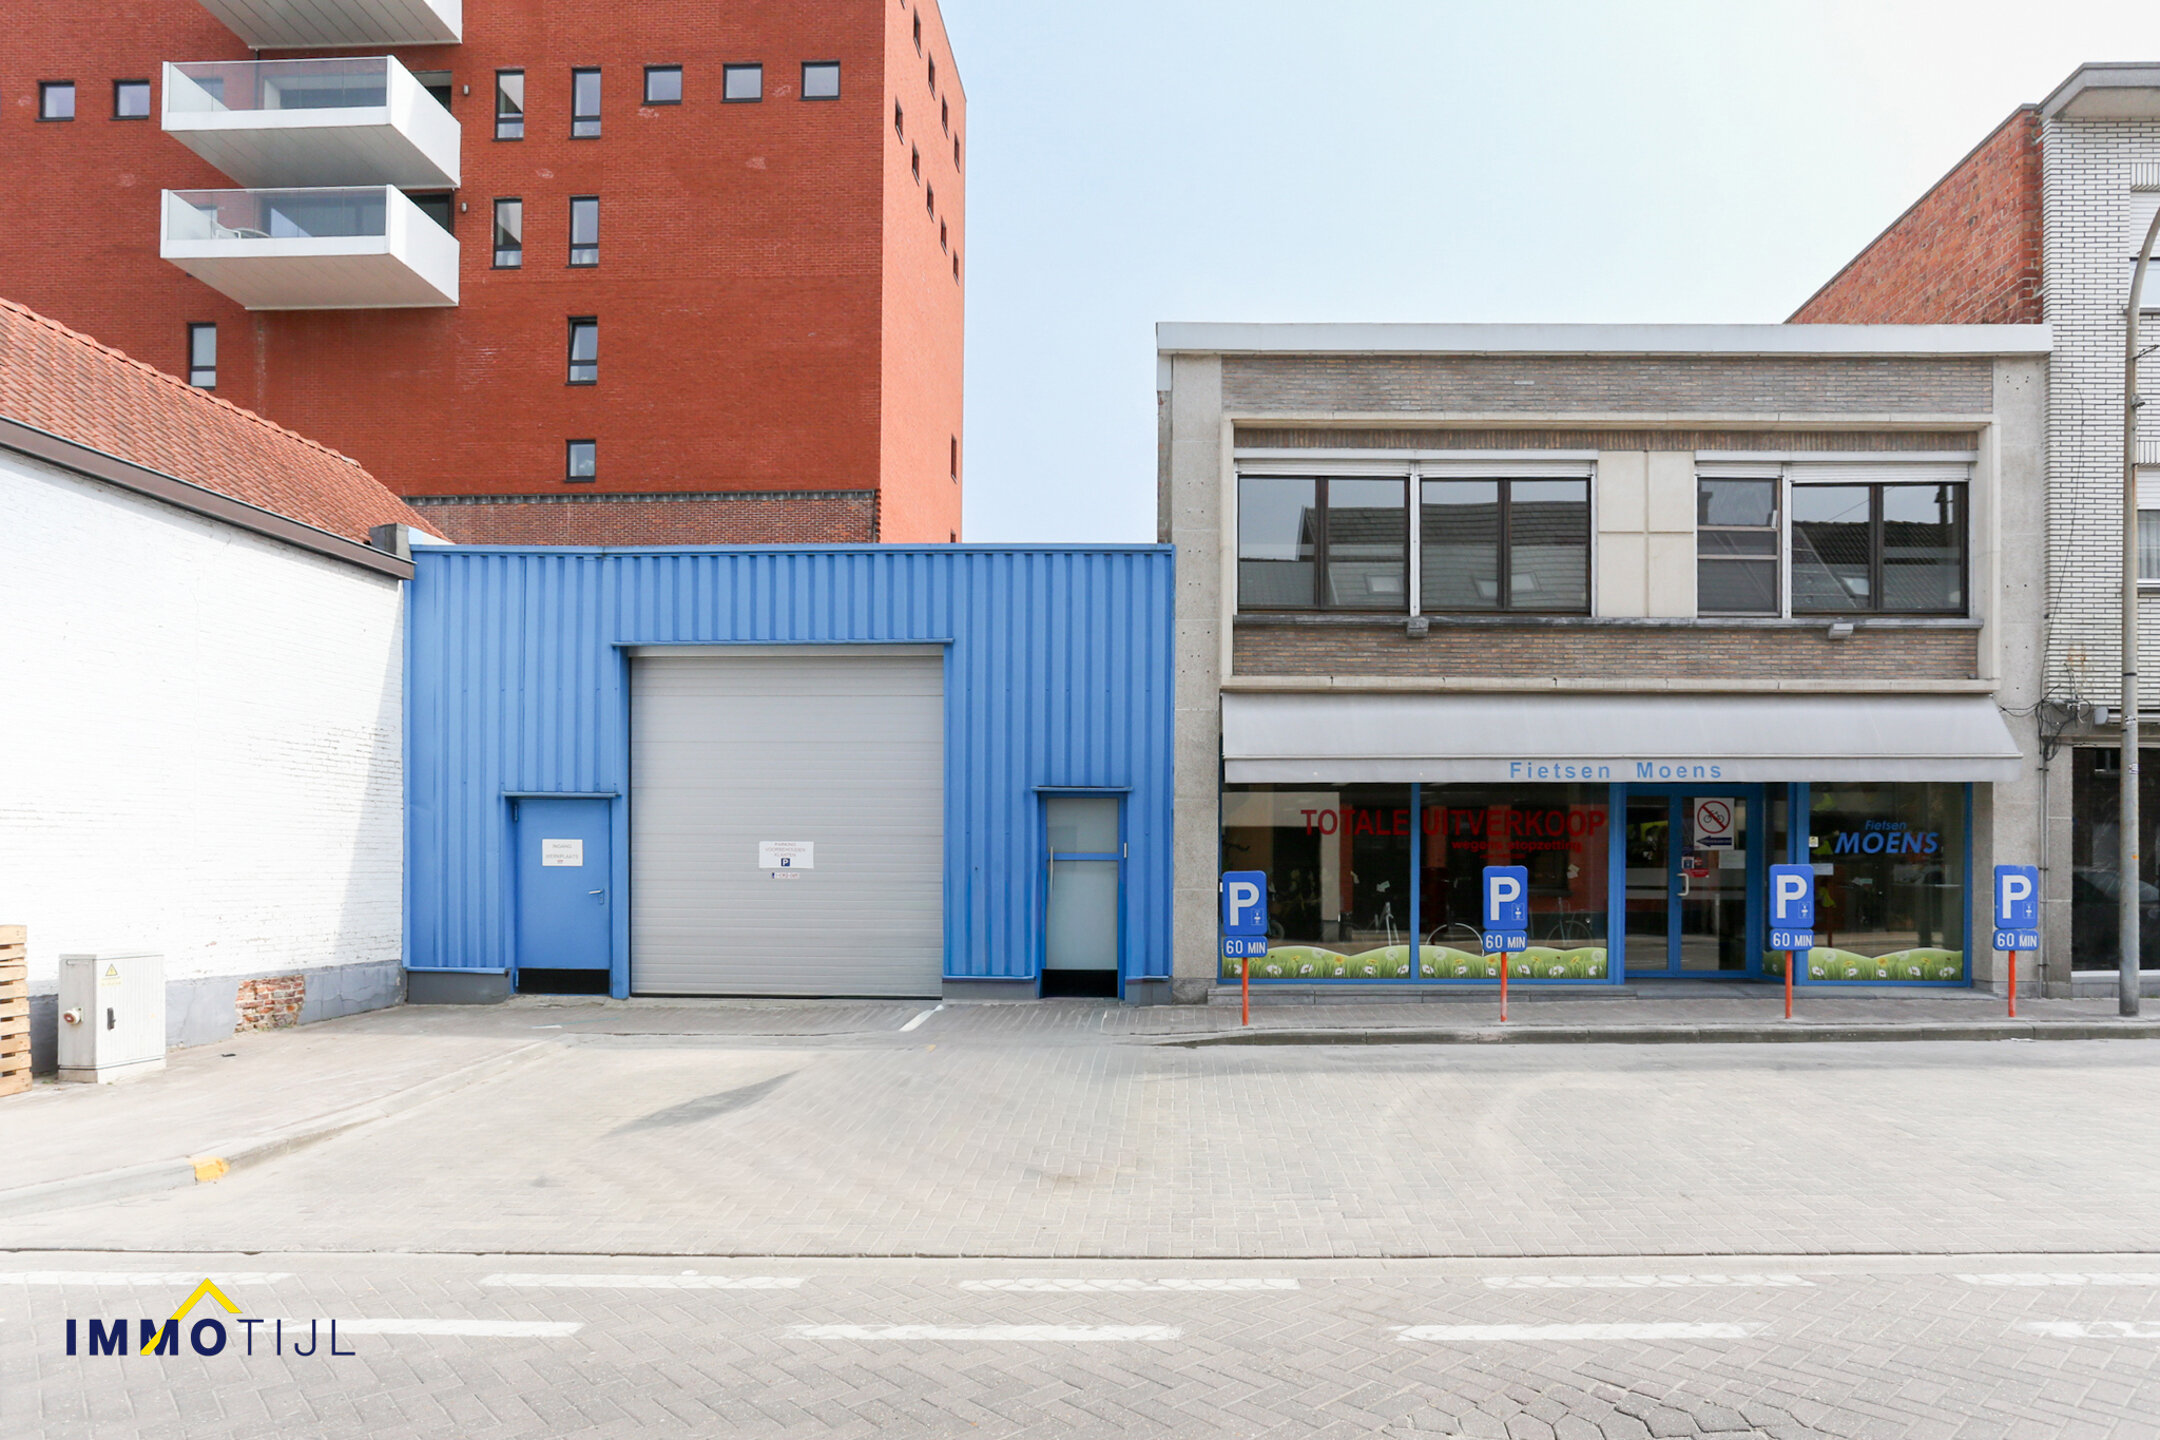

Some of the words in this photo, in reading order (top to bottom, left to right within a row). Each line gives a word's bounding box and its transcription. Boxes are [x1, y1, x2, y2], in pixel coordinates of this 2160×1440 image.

[1510, 762, 1610, 779] Fietsen
[1637, 762, 1722, 779] Moens
[1301, 809, 1410, 836] TOTALE
[1422, 810, 1605, 837] UITVERKOOP
[1865, 820, 1907, 831] Fietsen
[1451, 840, 1503, 852] wegens
[1507, 839, 1583, 853] stopzetting
[1834, 831, 1939, 854] MOENS
[1229, 882, 1259, 926] P
[1490, 877, 1521, 920] P
[1777, 875, 1807, 919] P
[2002, 875, 2032, 919] P
[1226, 940, 1243, 954] 60
[1248, 942, 1266, 954] MIN
[1486, 935, 1503, 949] 60
[1507, 937, 1526, 948] MIN
[1773, 933, 1790, 947] 60
[1795, 935, 1812, 947] MIN
[1997, 933, 2015, 947] 60
[2019, 935, 2037, 947] MIN
